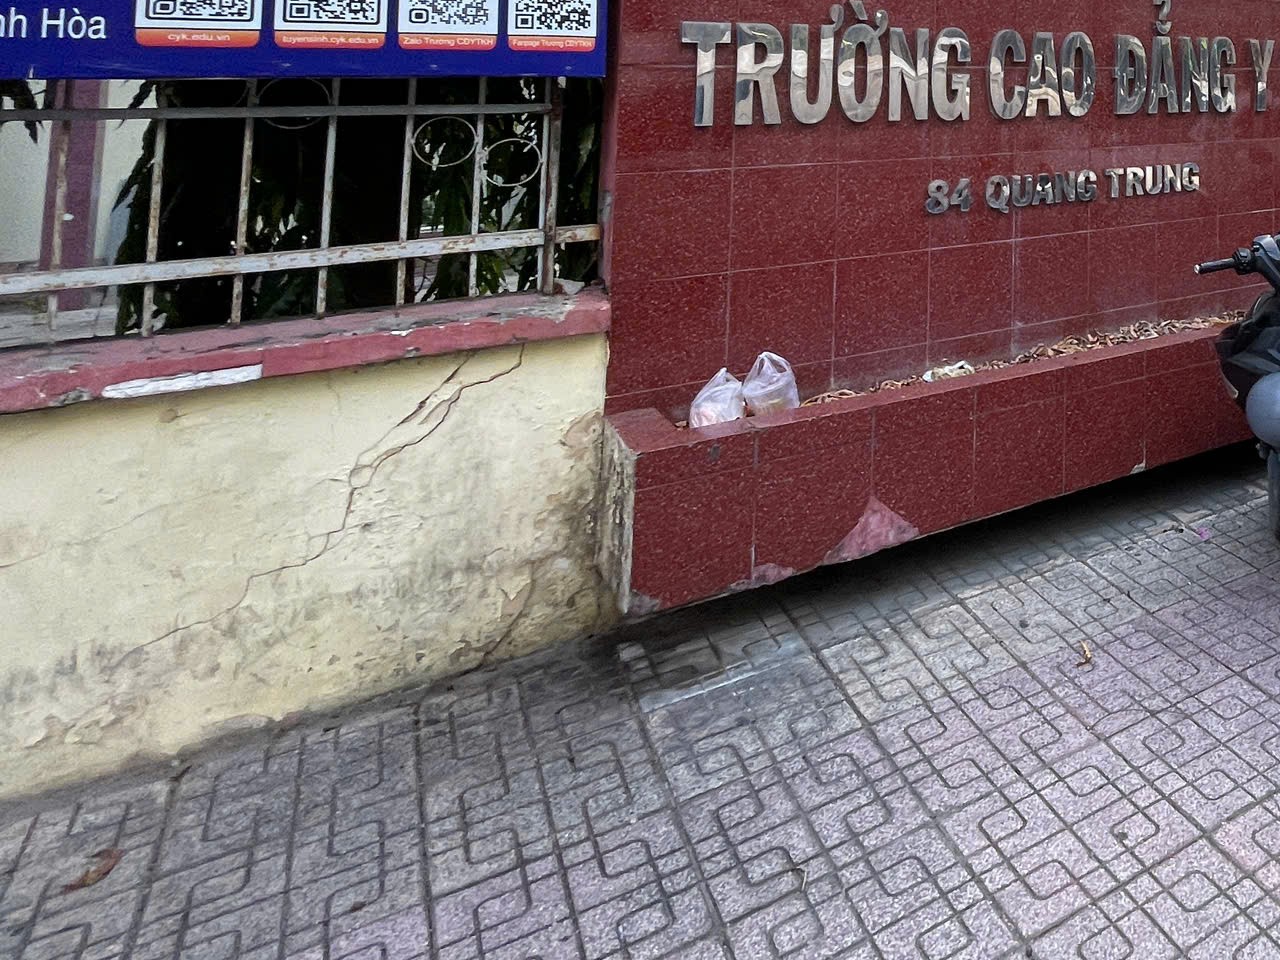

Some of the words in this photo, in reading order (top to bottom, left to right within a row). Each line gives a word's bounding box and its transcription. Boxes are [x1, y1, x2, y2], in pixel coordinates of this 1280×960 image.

[41, 7, 106, 39] Hòa
[168, 33, 230, 42] cyk.edu.vn
[282, 35, 379, 44] tuyensinh.cyk.edu.vn
[680, 0, 971, 127] TRƯỜNG
[988, 30, 1097, 120] CAO
[1250, 39, 1275, 112] Y
[925, 177, 971, 215] 84
[985, 169, 1097, 214] QUANG
[1105, 161, 1200, 199] TRUNG
